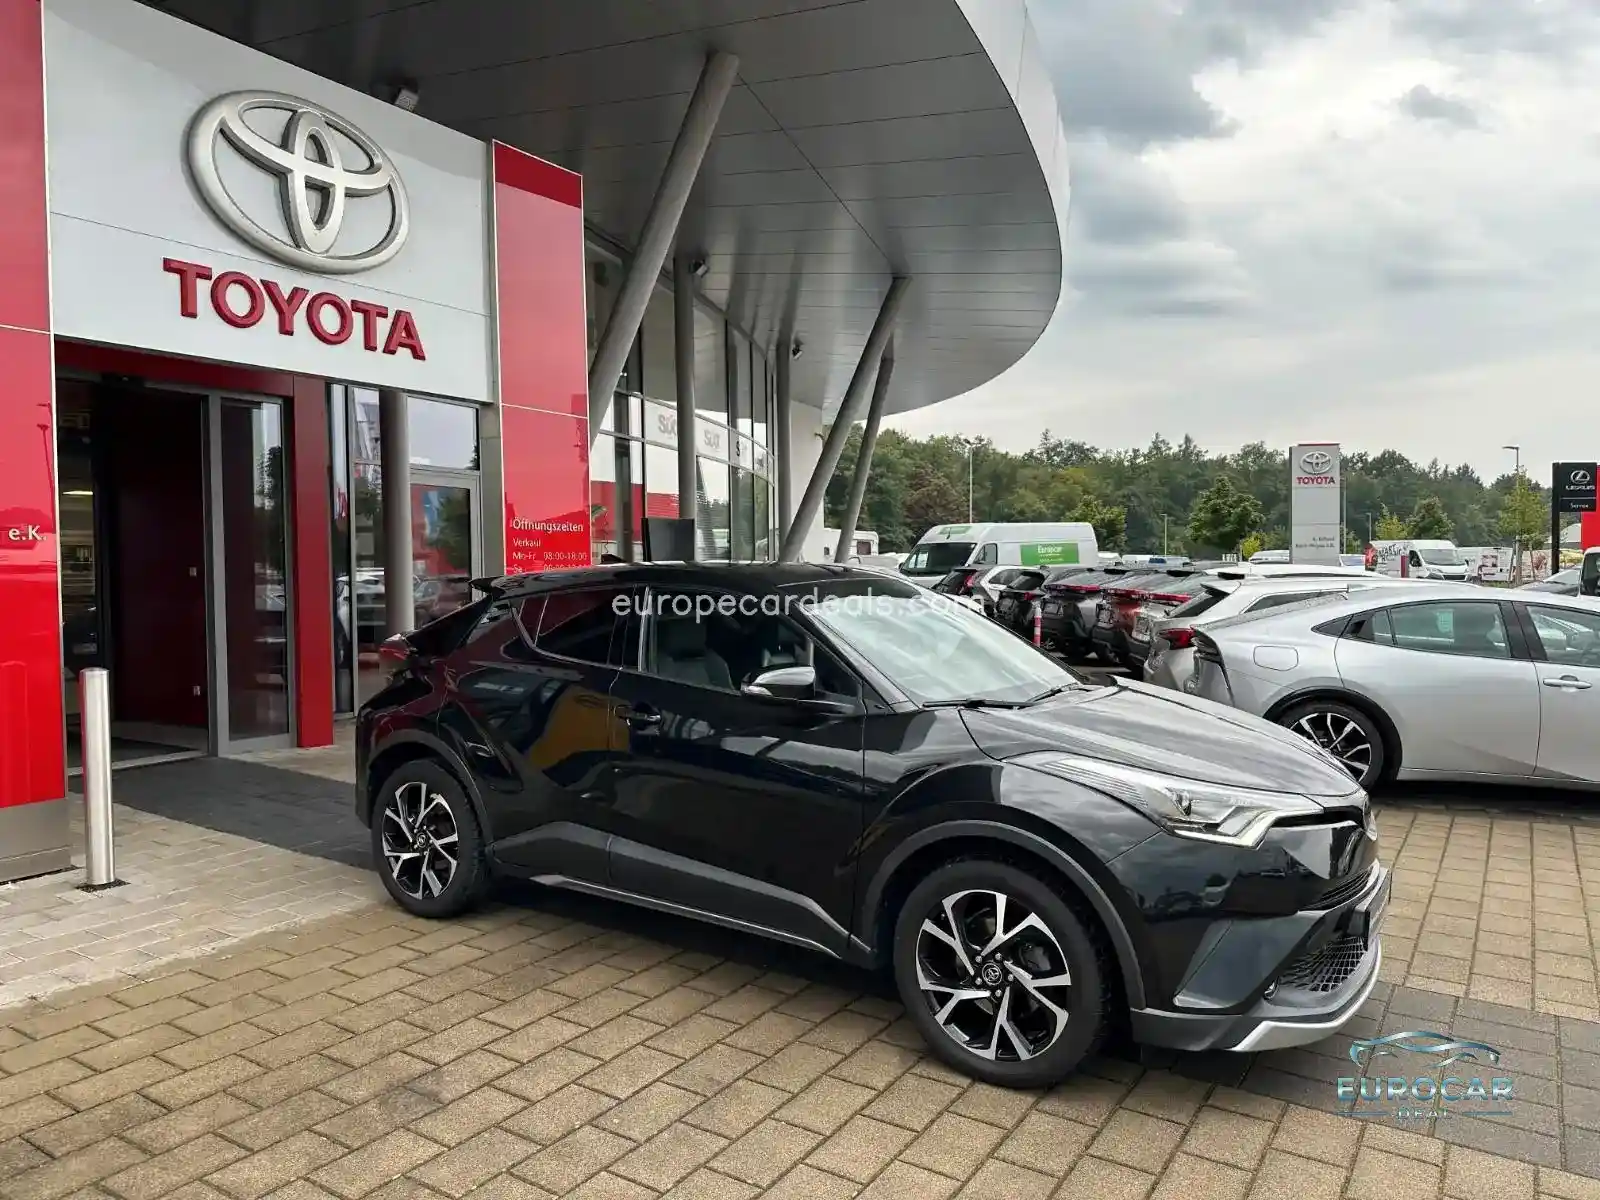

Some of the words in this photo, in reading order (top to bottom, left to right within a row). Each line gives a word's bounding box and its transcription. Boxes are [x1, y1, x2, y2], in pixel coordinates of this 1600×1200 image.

[162, 257, 426, 361] TOYOTA
[1296, 476, 1336, 486] TOYOTA
[8, 524, 48, 541] e.K.
[511, 516, 584, 534] Öffnungszeiten
